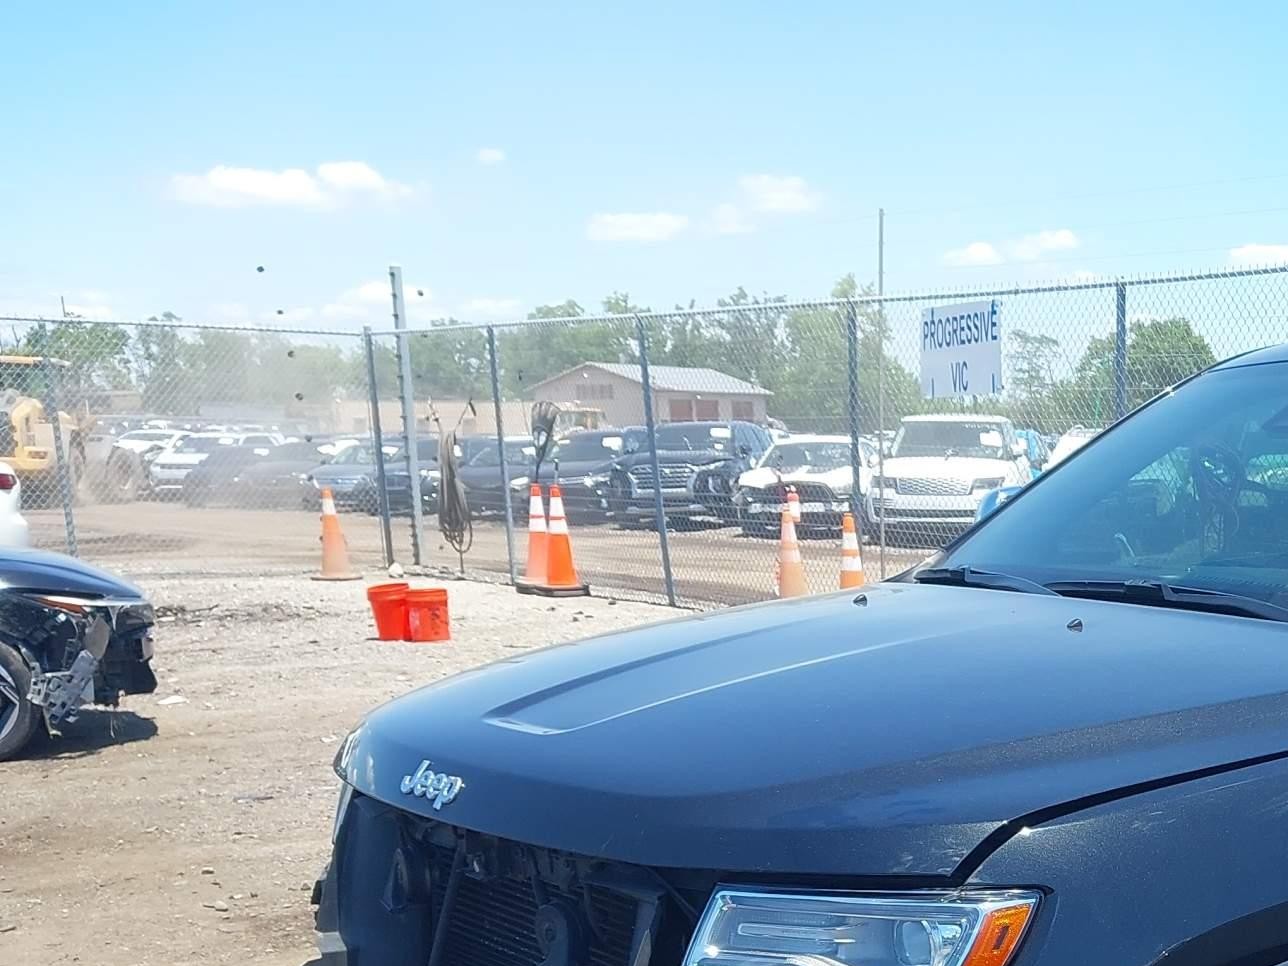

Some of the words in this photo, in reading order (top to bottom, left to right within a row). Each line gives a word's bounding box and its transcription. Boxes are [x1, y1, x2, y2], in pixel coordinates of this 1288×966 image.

[922, 310, 998, 352] PROGRESSIVE
[950, 360, 968, 393] VIC
[400, 760, 463, 810] Jeep
